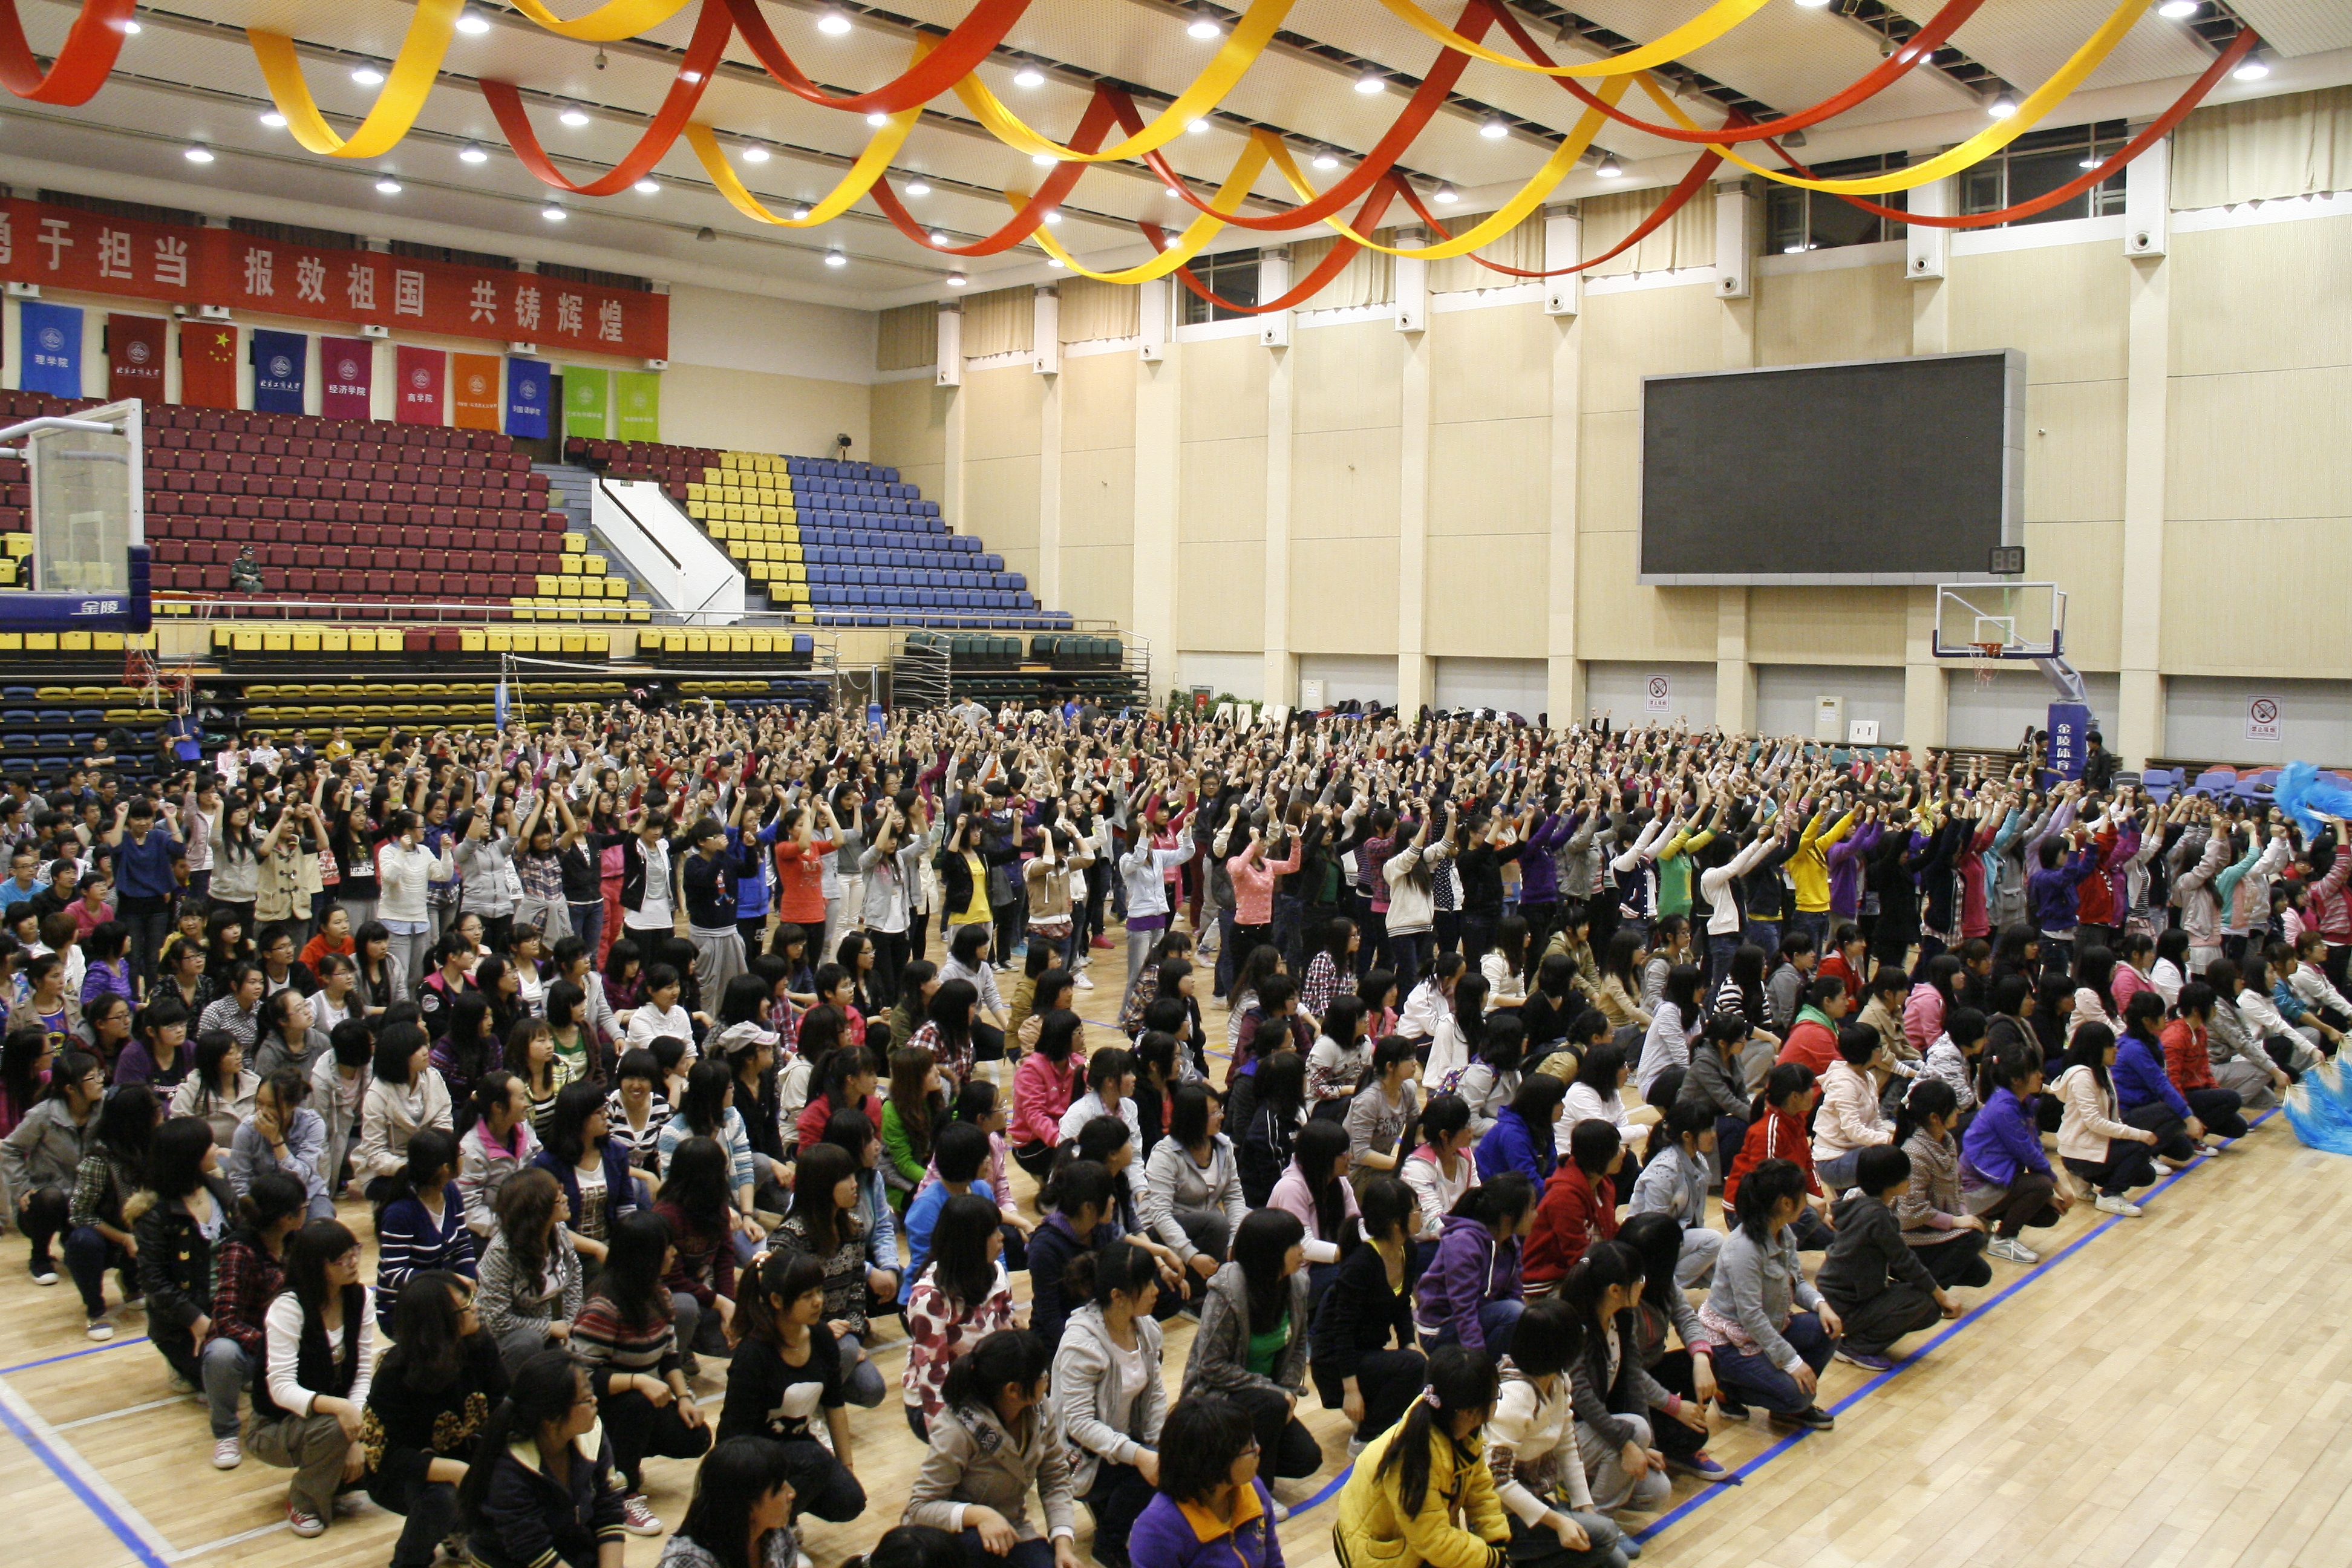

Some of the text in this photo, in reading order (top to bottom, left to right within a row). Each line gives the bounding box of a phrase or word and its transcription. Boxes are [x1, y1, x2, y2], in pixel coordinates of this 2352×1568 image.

[244, 247, 424, 317] 报效祖国
[470, 279, 623, 343] 共铸辉煌
[35, 354, 69, 368] 理学院
[328, 384, 367, 396] 经济学院
[408, 393, 433, 403] 商学院
[81, 600, 119, 615] 金陵
[2056, 724, 2071, 770] 金陵体育
